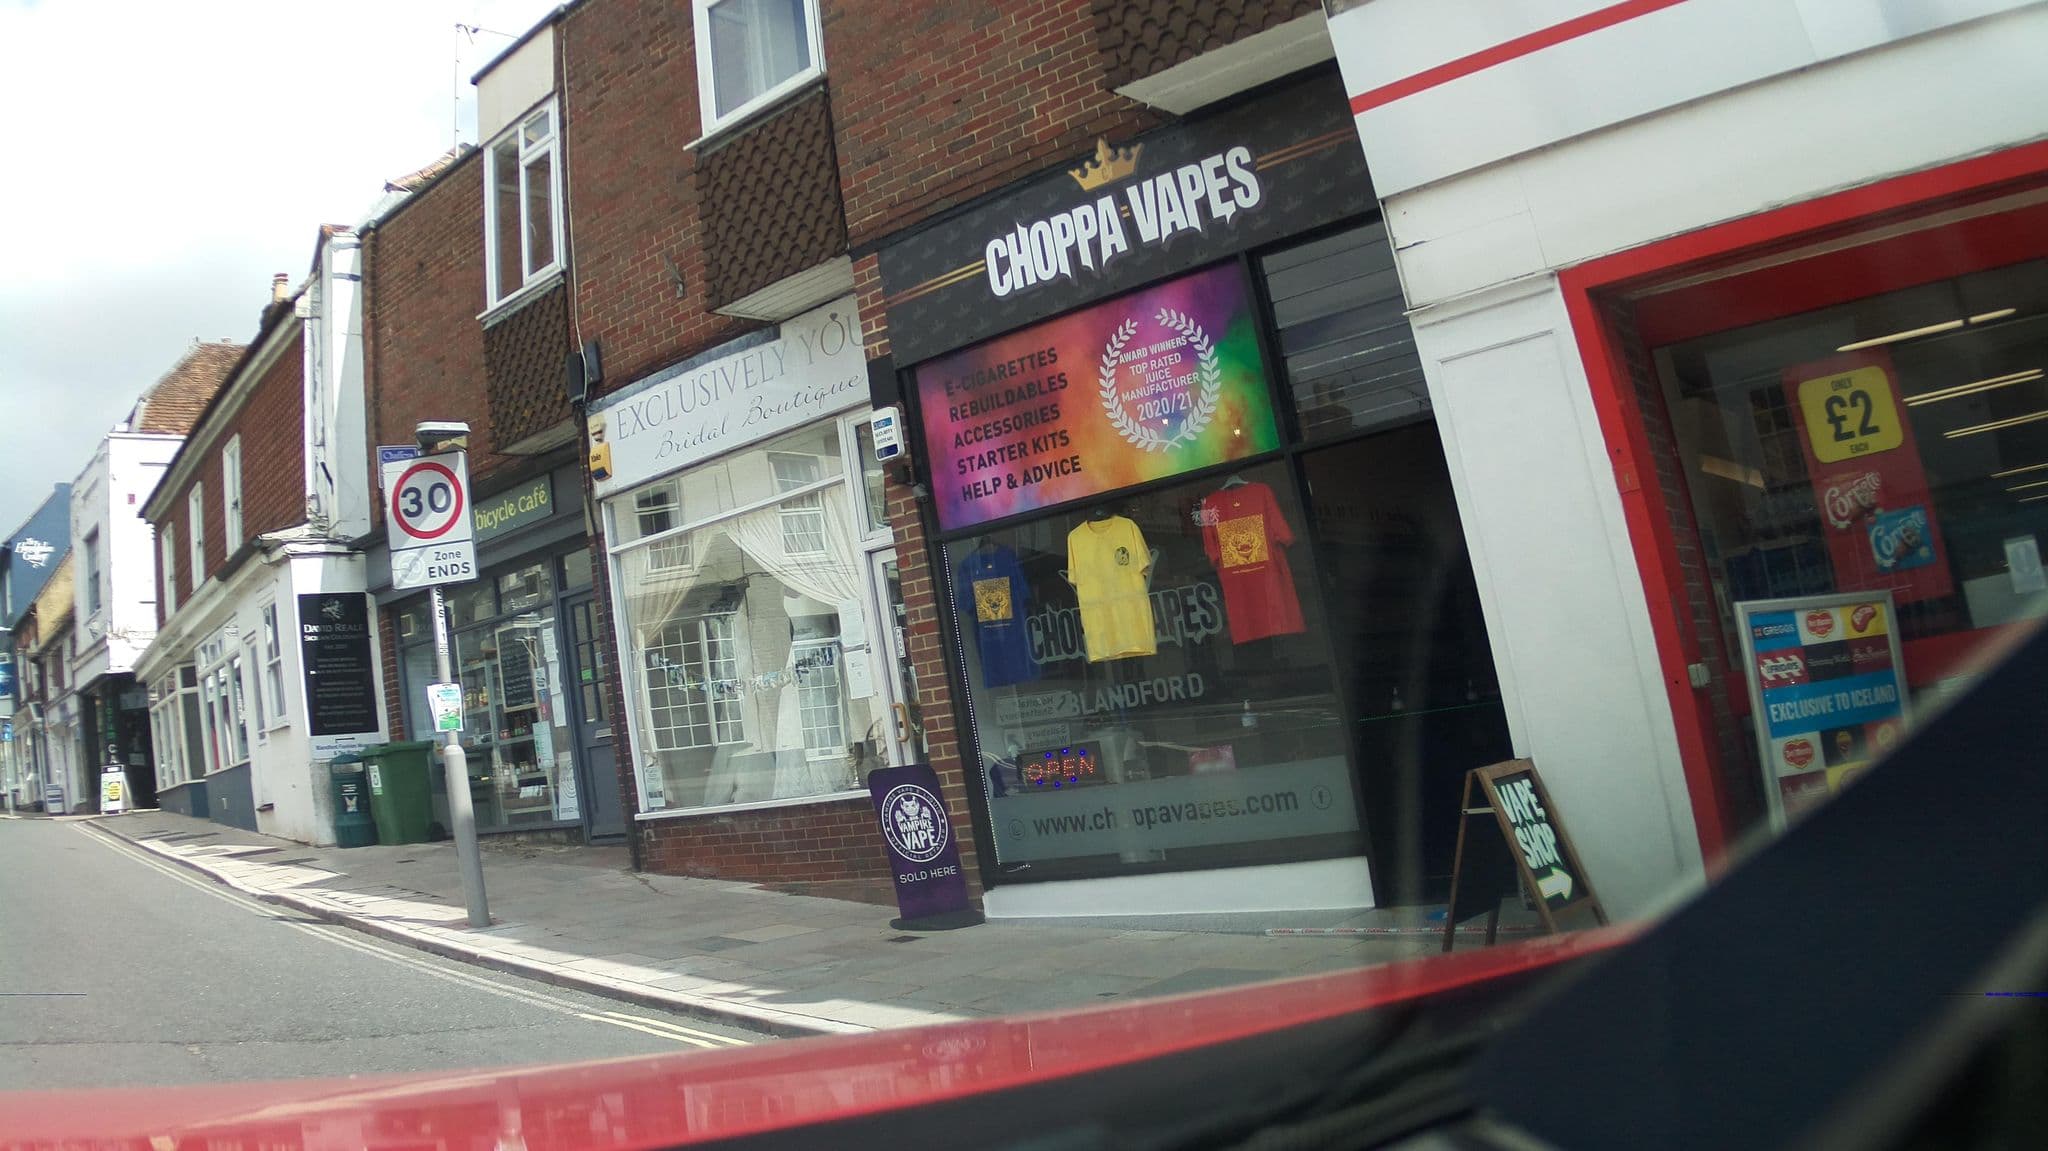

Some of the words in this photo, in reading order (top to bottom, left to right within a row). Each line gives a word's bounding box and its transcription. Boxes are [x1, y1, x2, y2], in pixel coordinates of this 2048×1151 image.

[985, 195, 1129, 297] CHOPPA
[1126, 146, 1261, 244] VAPES
[1120, 348, 1147, 364] AWARD
[1149, 335, 1188, 355] WINNERS
[1129, 362, 1148, 376] TOP
[1150, 352, 1181, 371] RATED
[616, 341, 789, 441] EXCLUSIVELY
[945, 347, 1058, 397] E-CIGARETTES
[1121, 372, 1200, 402] MANUFACTURER
[1145, 368, 1172, 384] JUICE
[654, 418, 729, 460] Bridal
[740, 373, 866, 428] Boutique
[949, 372, 1068, 422] REBUILDABLES
[1137, 390, 1193, 421] 2020/21
[1825, 390, 1880, 442] £2
[954, 403, 1060, 449] ACCESSORIES
[958, 443, 1028, 475] STARTER
[1031, 429, 1070, 454] KITS
[962, 477, 1002, 502] HELP
[1006, 473, 1018, 490] &
[1022, 455, 1082, 486] ADVICE
[401, 482, 450, 518] 30
[474, 500, 517, 531] bicycle
[518, 483, 548, 513] Café
[428, 562, 470, 579] ENDS
[435, 550, 462, 561] Zone
[1071, 673, 1204, 714] BLANDFORD
[1769, 695, 1834, 723] EXCLUSIVE
[1834, 693, 1849, 710] TO
[1851, 684, 1896, 709] ICELAND
[1028, 756, 1094, 781] OPEN
[1033, 790, 1298, 835] www.chppavapes.com
[1494, 779, 1546, 826] VAPE
[898, 820, 934, 833] VAMPIRE
[902, 829, 939, 850] VAPE
[1515, 822, 1565, 869] SHOP
[900, 870, 928, 884] SOLD
[930, 866, 957, 879] HERE
